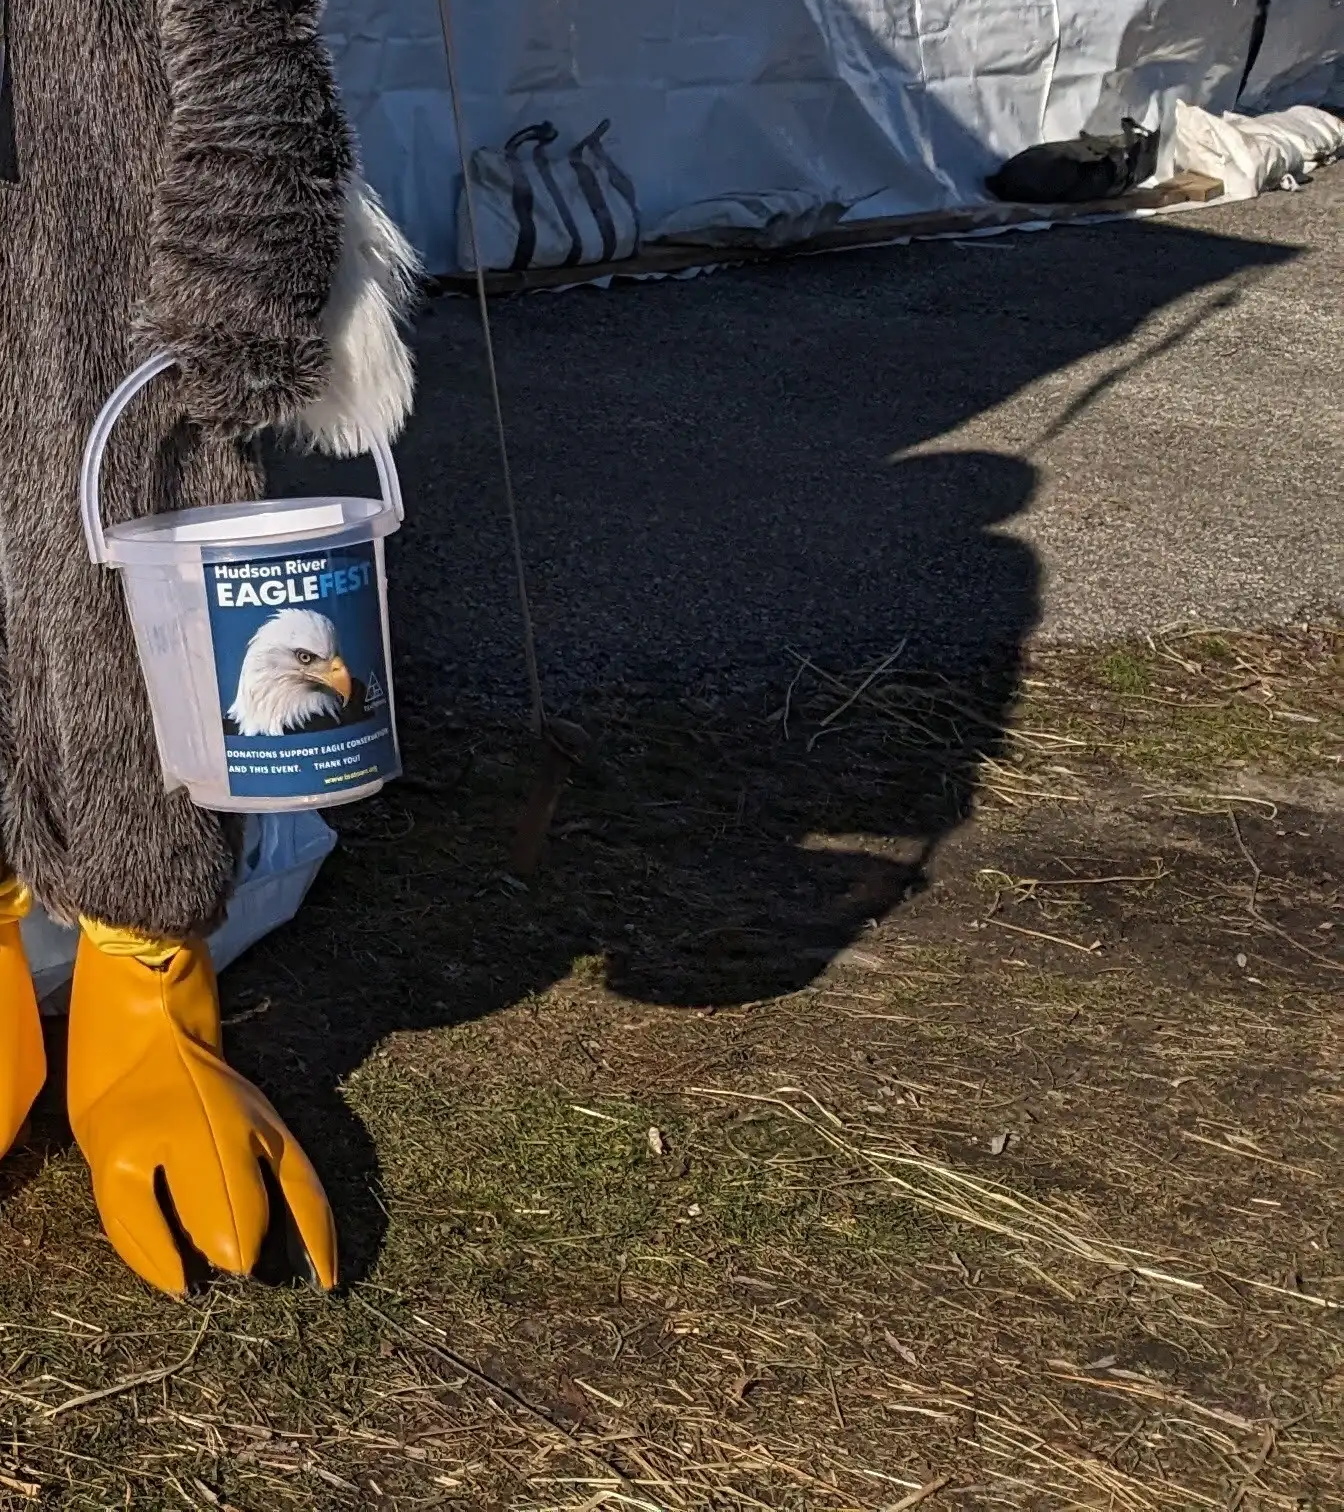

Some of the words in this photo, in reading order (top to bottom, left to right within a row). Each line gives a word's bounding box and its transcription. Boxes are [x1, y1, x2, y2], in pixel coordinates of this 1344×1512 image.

[214, 564, 281, 579] Hudson
[285, 558, 327, 575] River
[216, 561, 371, 607] EAGLEFEST
[227, 750, 277, 759] DONATIONS
[280, 747, 319, 758] SUPPORT
[321, 742, 345, 754] EAGLE
[228, 765, 247, 774] AND
[249, 765, 269, 774] THIS
[271, 764, 302, 774] EVENT.
[313, 759, 341, 771] THANK
